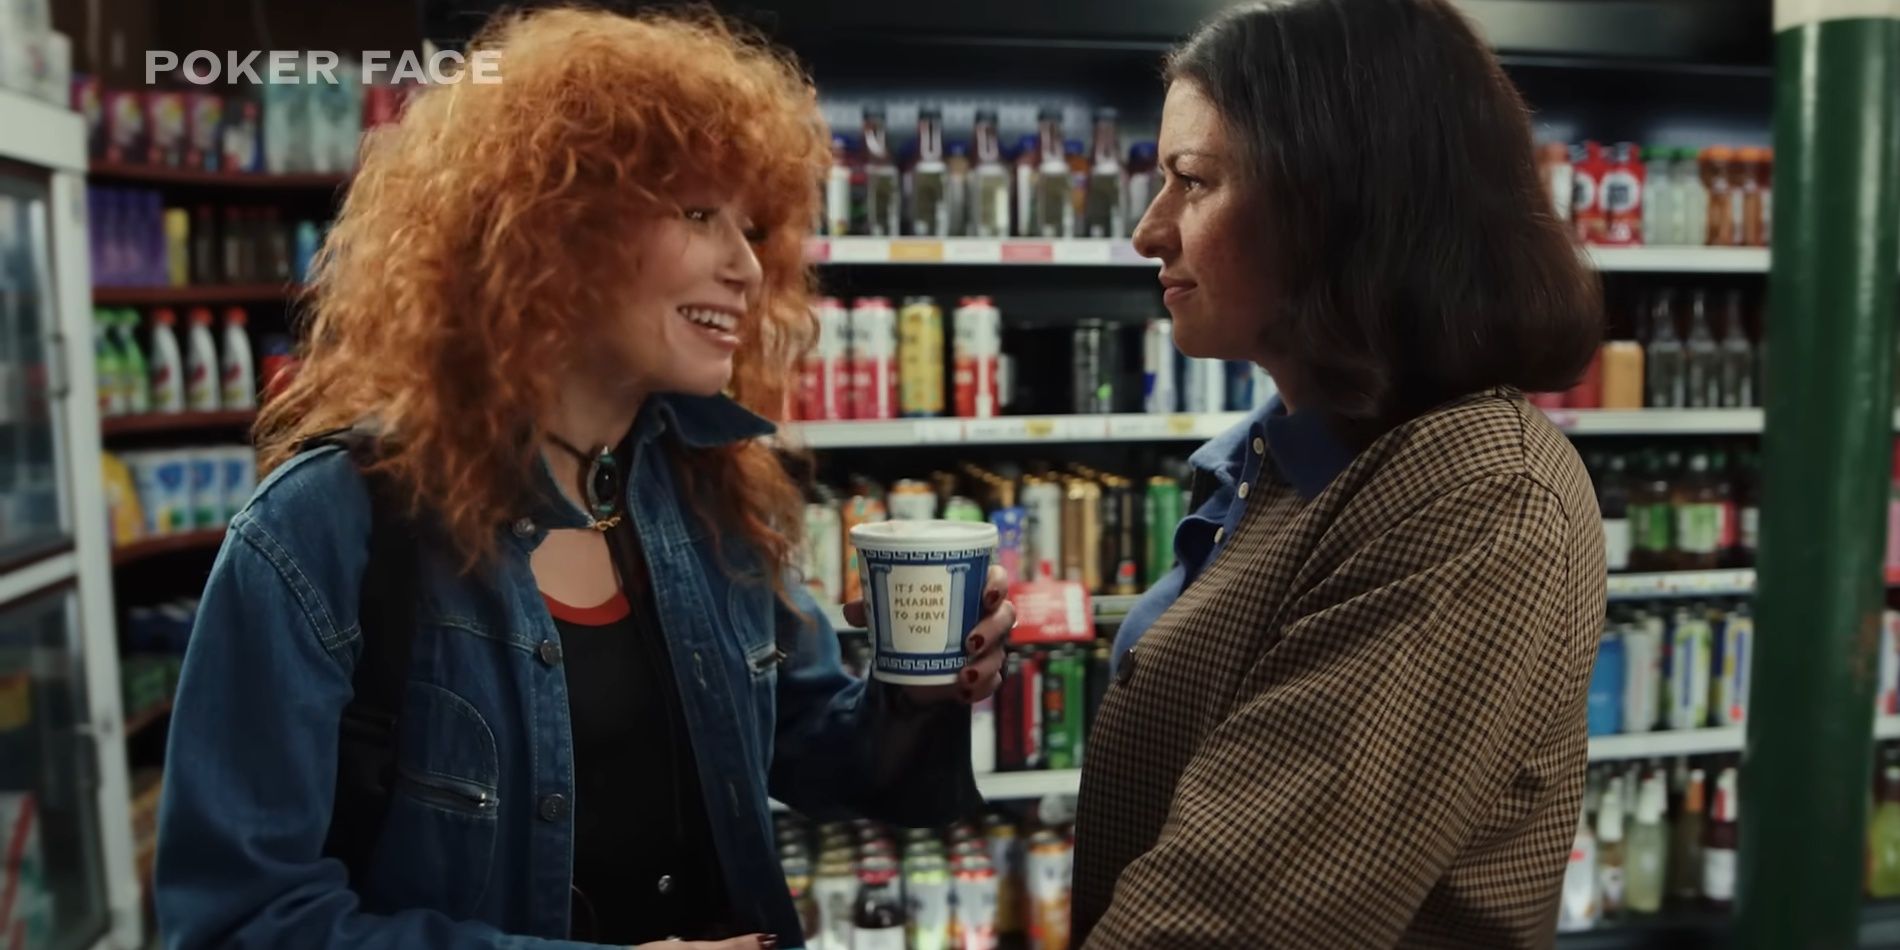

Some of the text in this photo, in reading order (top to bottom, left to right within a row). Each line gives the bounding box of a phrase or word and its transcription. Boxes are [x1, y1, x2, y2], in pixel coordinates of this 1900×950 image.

[895, 584, 943, 594] IT'S OUR
[895, 597, 944, 607] PLEASURE
[895, 610, 945, 620] TO SERVE
[909, 625, 931, 634] YOU
